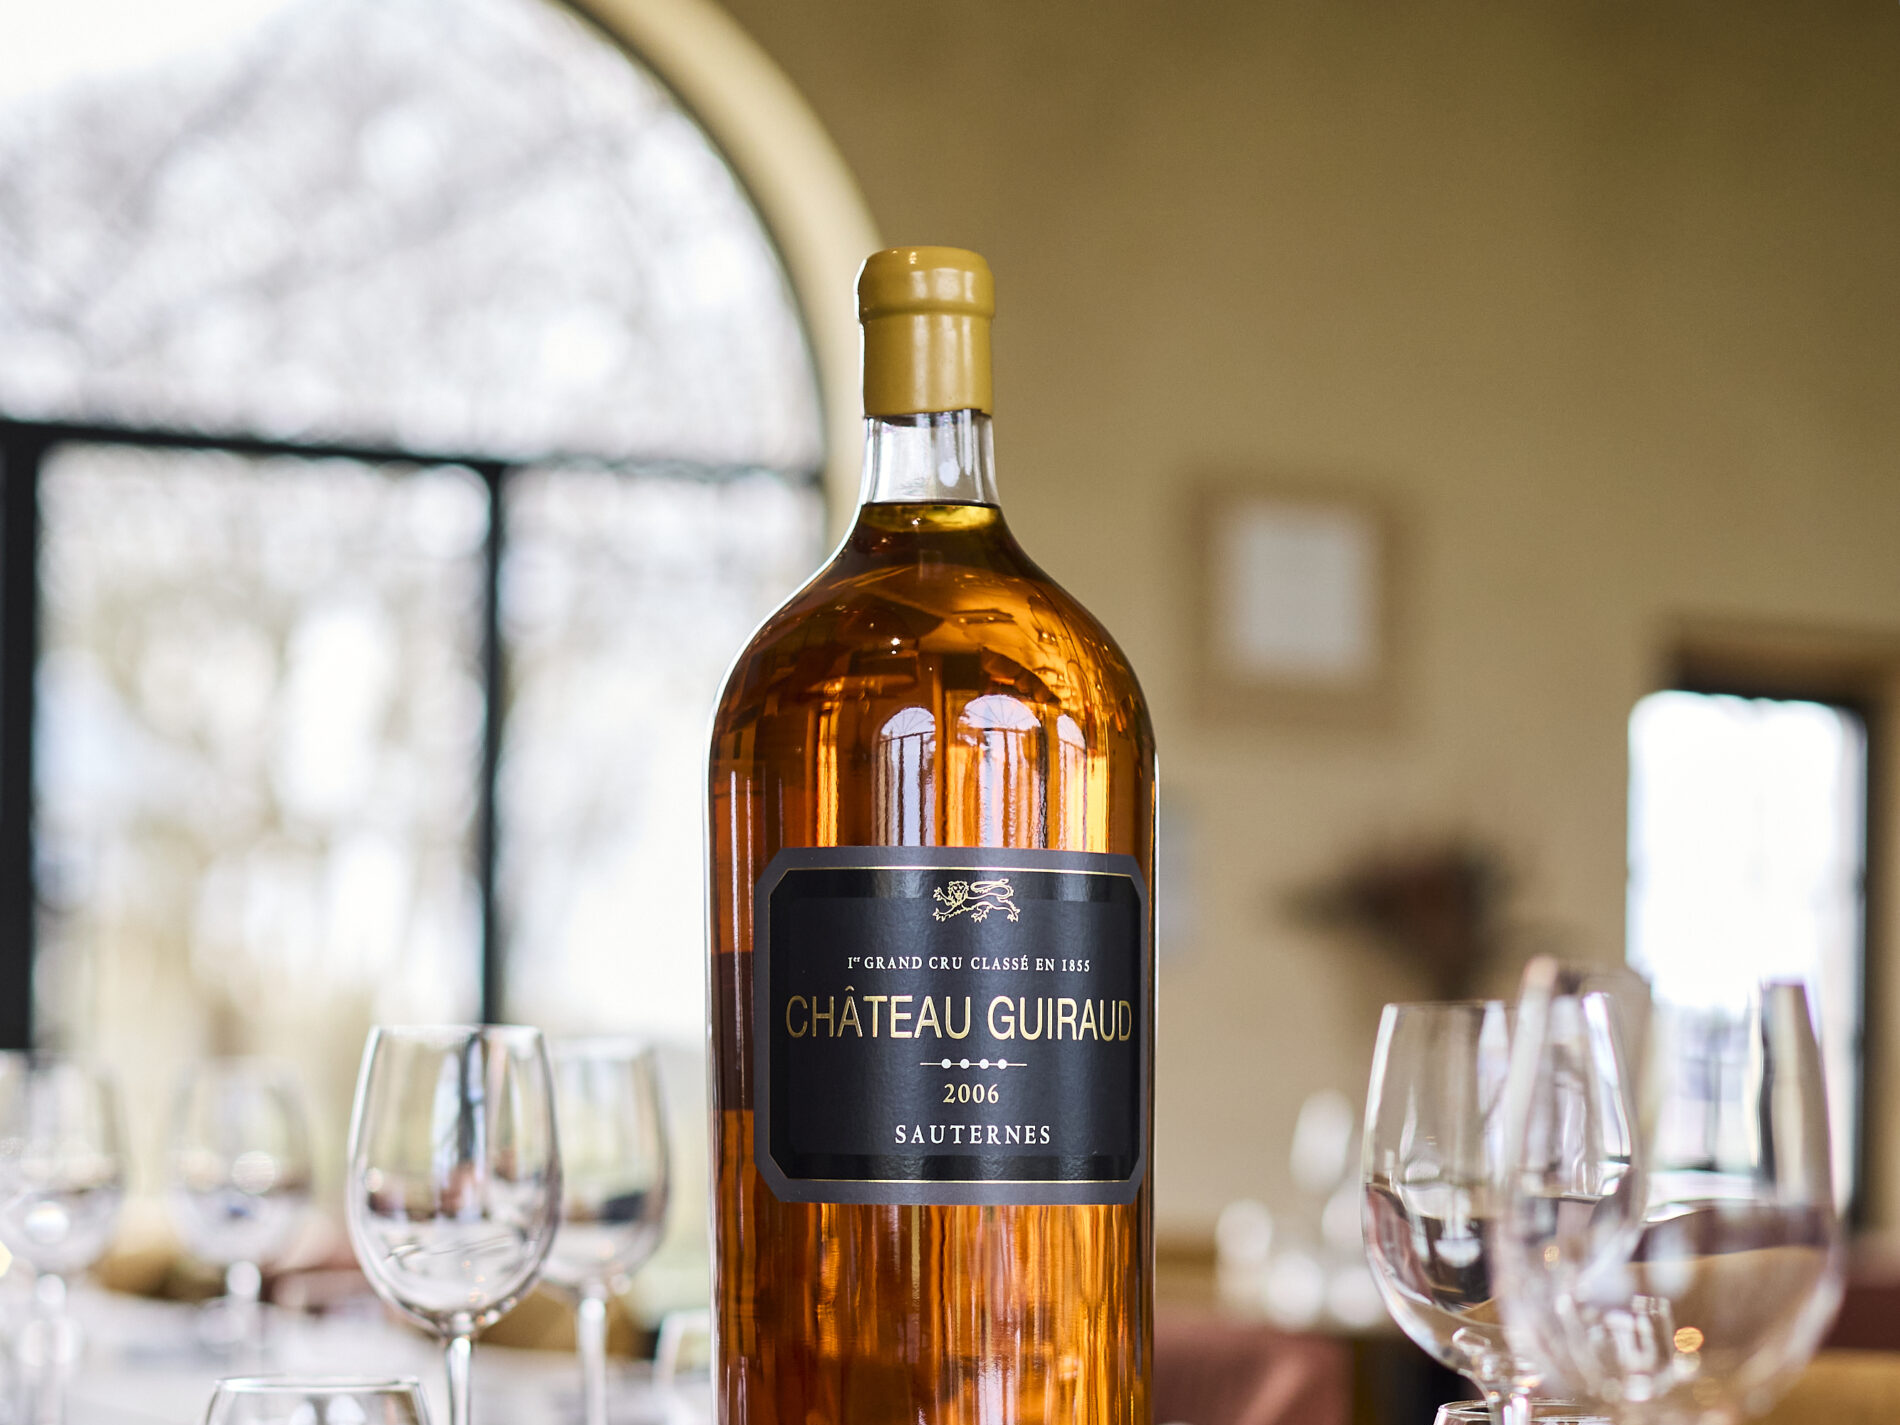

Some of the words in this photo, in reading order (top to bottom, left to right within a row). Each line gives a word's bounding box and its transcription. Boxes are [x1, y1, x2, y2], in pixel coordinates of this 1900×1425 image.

[864, 956, 922, 970] GRAND
[928, 956, 963, 970] CRU
[970, 955, 1029, 971] CLASSÉ
[1035, 958, 1055, 972] EN
[1061, 959, 1090, 973] 1855
[785, 985, 970, 1040] CHÂTEAU
[987, 996, 1132, 1041] GUIRAUD
[943, 1083, 1000, 1104] 2006
[894, 1125, 1051, 1145] SAUTERNES
